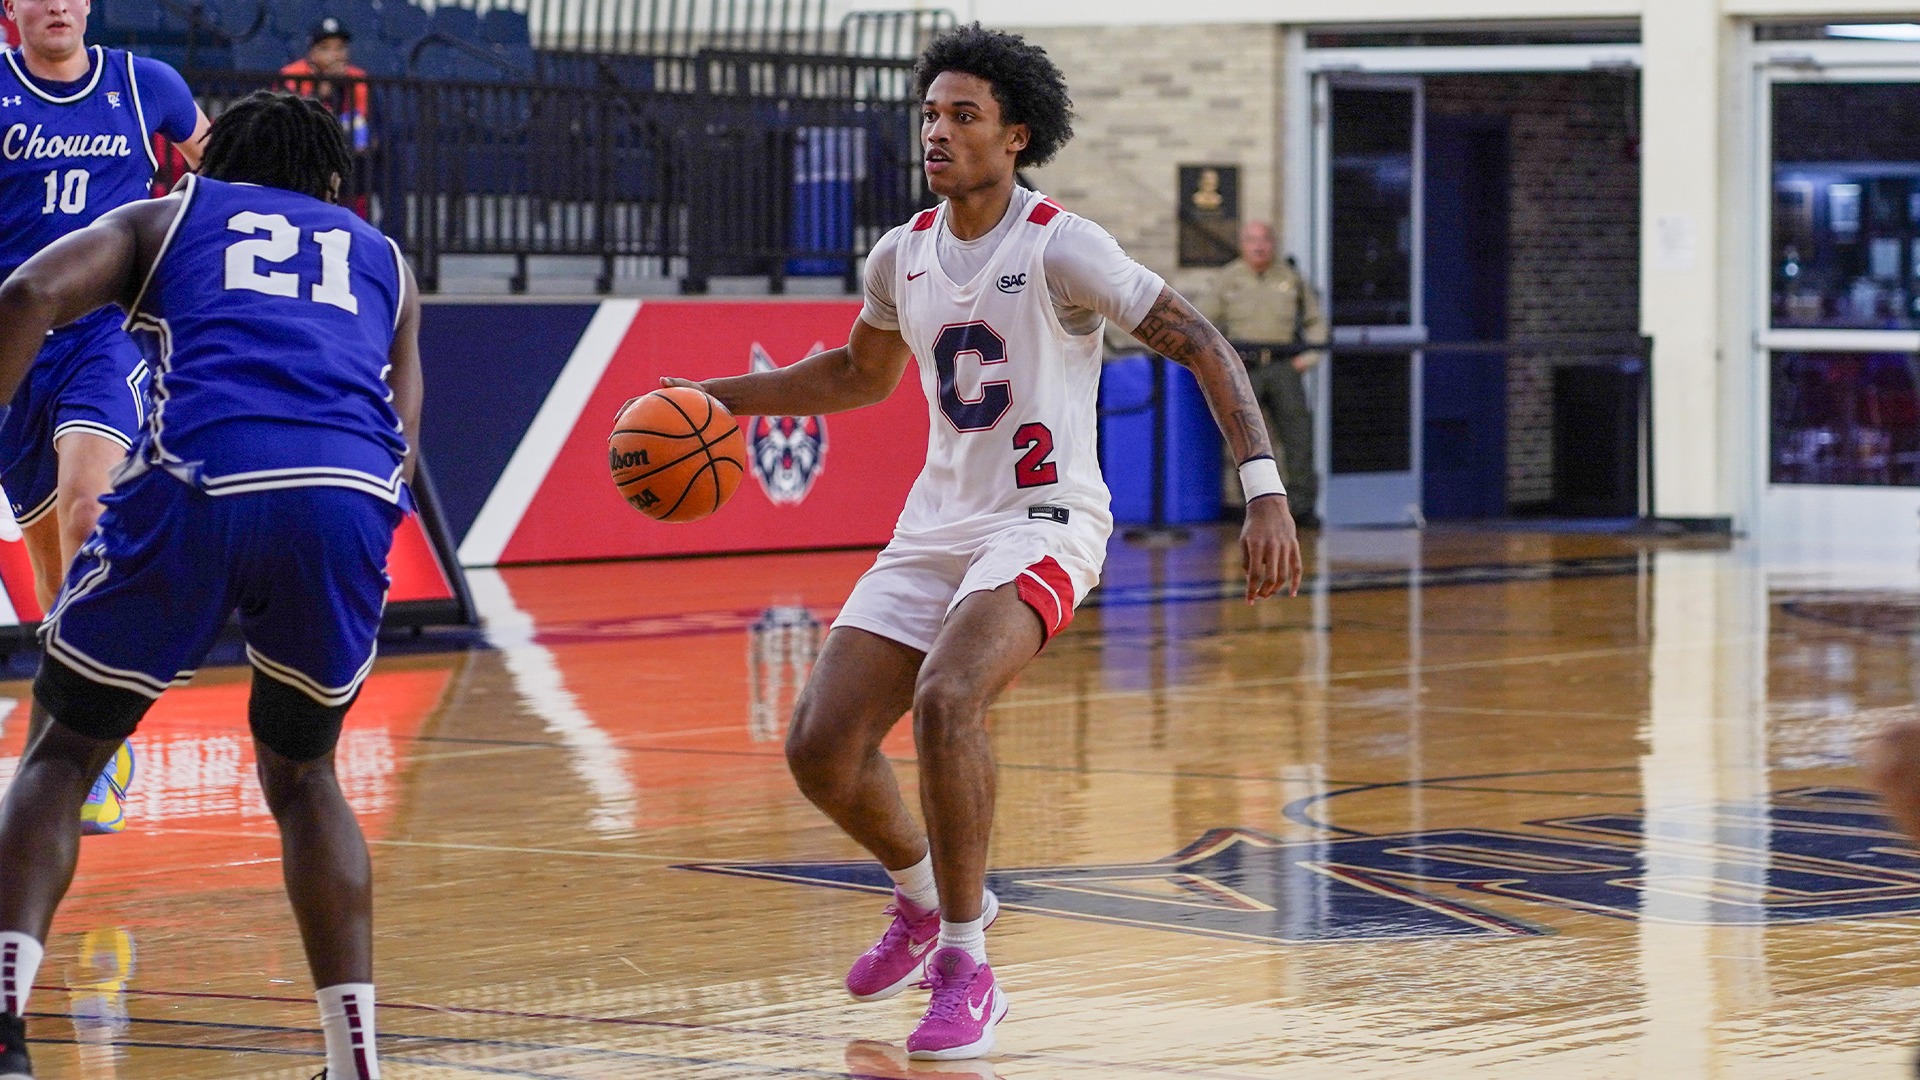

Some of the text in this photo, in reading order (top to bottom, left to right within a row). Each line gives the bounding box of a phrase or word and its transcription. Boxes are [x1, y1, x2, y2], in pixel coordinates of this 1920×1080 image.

[2, 123, 131, 160] Chowan
[42, 169, 90, 215] 10
[225, 211, 358, 315] 21
[1000, 273, 1026, 288] SAC
[932, 320, 1013, 434] C
[1013, 422, 1058, 489] 2
